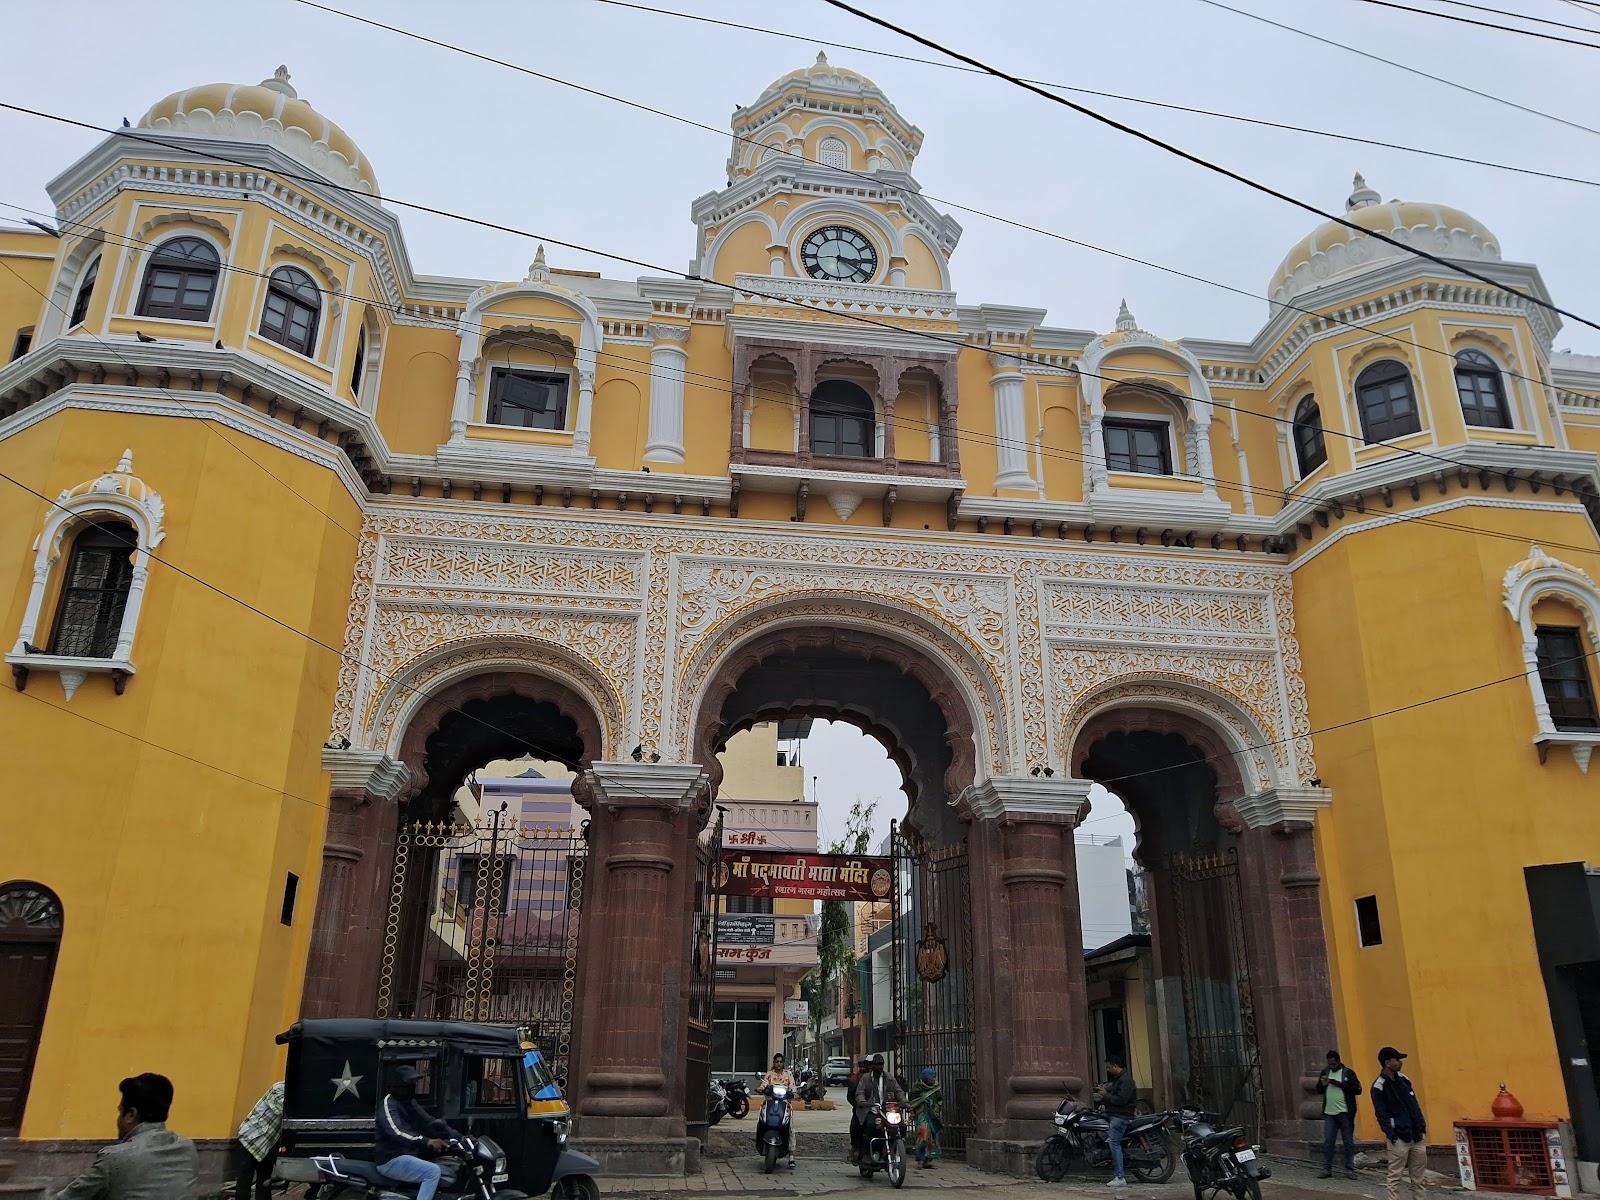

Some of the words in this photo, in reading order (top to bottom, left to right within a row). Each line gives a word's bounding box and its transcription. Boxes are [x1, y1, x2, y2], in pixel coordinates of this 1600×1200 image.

[740, 831, 756, 844] श्री
[750, 858, 807, 885] पद्मावती
[808, 866, 838, 882] माता
[840, 861, 870, 883] मंदिर
[816, 886, 847, 897] महोत्सव
